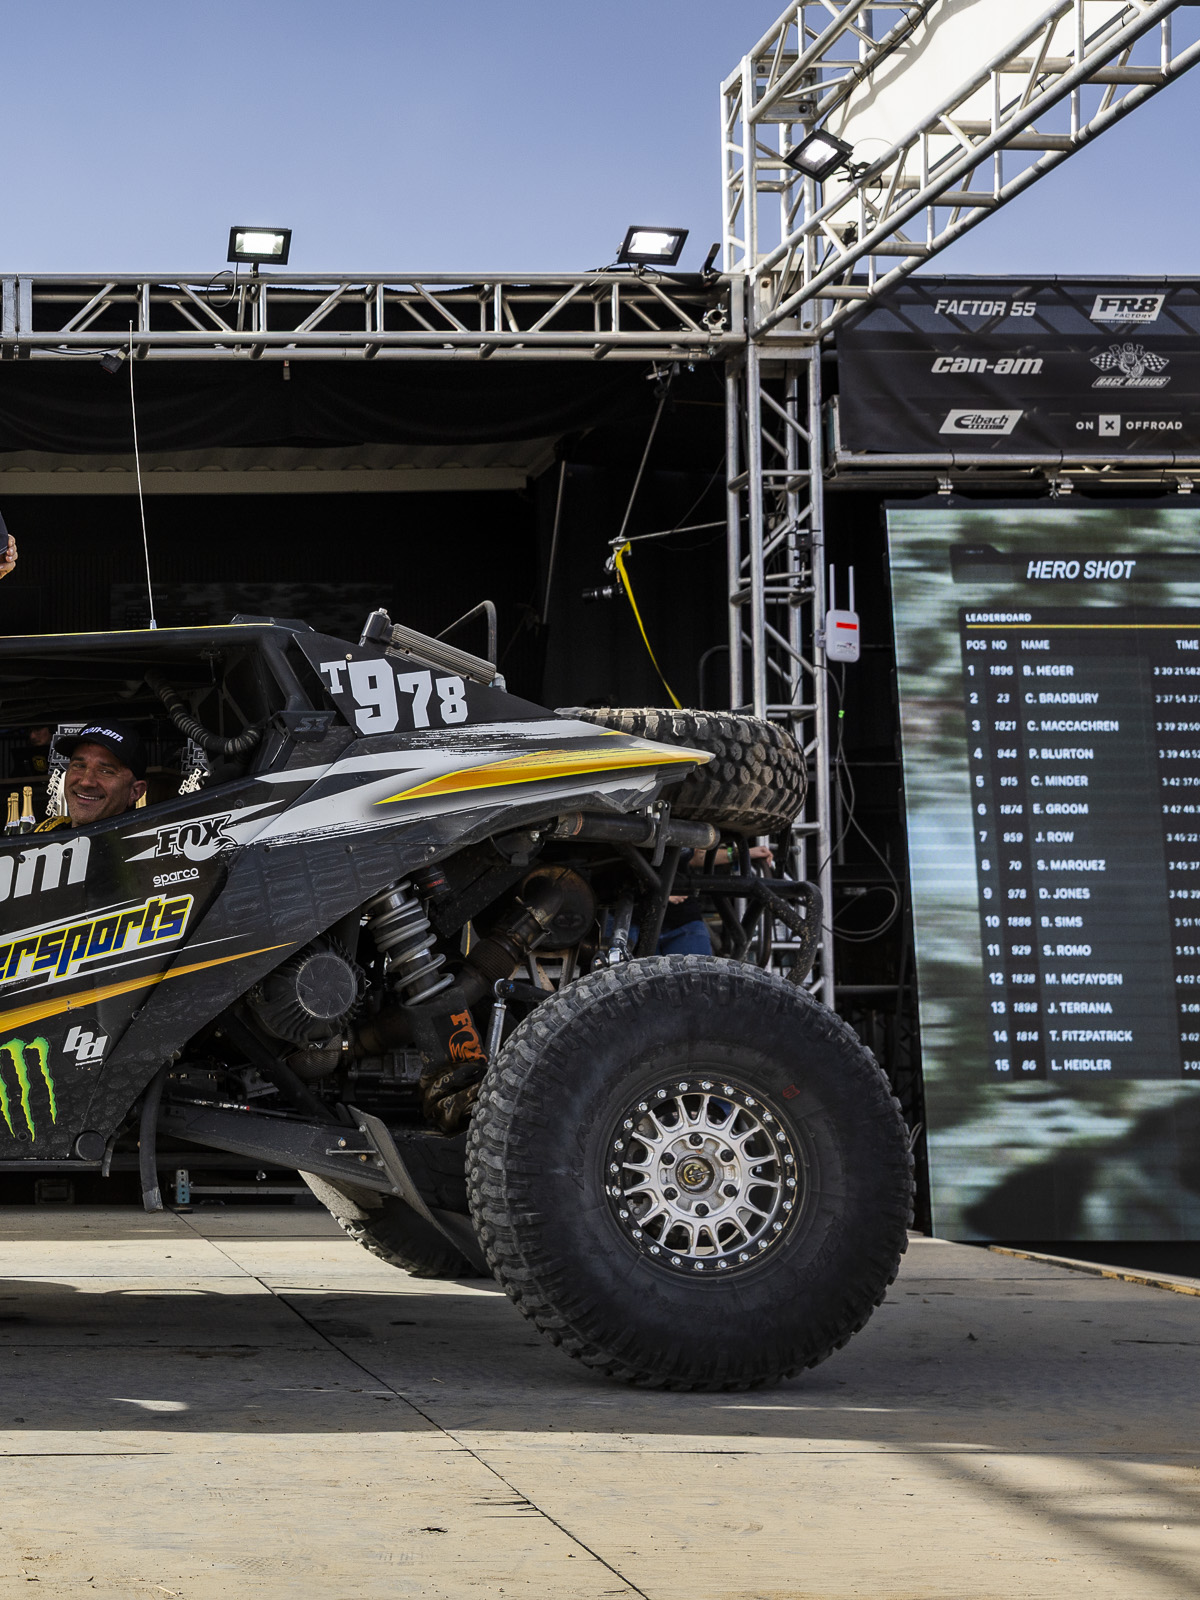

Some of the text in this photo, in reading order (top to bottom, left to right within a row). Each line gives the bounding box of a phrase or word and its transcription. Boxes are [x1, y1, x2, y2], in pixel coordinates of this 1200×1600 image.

[934, 299, 1037, 317] FACTOR 55
[1099, 297, 1159, 312] FR8
[931, 357, 1043, 375] can-am
[1095, 377, 1123, 387] RACE
[953, 413, 1009, 430] Eibach
[1076, 421, 1094, 430] ON
[1125, 420, 1183, 431] OFFROAD
[1026, 560, 1136, 579] HERO SHOT
[965, 613, 1032, 623] LEADERBOARD
[966, 639, 1199, 651] POS NO NAME TIME
[967, 664, 975, 676] 1
[1022, 665, 1035, 676] B.
[1035, 664, 1074, 676] HEGER
[969, 692, 979, 704] 2
[1024, 692, 1037, 704] C.
[1038, 692, 1099, 704] BRADBURY
[971, 719, 981, 732] 3
[1026, 720, 1039, 732] C.
[1040, 720, 1119, 732] MACCACHREN
[81, 726, 124, 743] can-am
[973, 747, 983, 760] 4
[1028, 748, 1040, 759] P.
[1040, 748, 1094, 760] BLURTON
[975, 775, 985, 788] 5
[1030, 775, 1043, 787] C.
[1044, 775, 1089, 787] MINDER
[977, 803, 987, 816] 6
[1032, 803, 1044, 815] E.
[1045, 803, 1089, 815] GROOM
[155, 814, 237, 861] FOX
[979, 830, 988, 843] 7
[1034, 831, 1046, 843] J.
[1046, 831, 1074, 843] ROW
[981, 859, 991, 871] 8
[1036, 859, 1049, 871] S.
[1049, 859, 1106, 872] MARQUEZ
[153, 867, 200, 887] sparco
[983, 887, 993, 900] 9
[1038, 887, 1052, 900] D.
[1052, 887, 1091, 900] JONES
[985, 915, 1000, 928] 10
[1040, 915, 1053, 928] B.
[1054, 915, 1083, 928] SIMS
[986, 943, 1000, 957] 11
[1042, 944, 1056, 957] S.
[1056, 944, 1092, 957] ROMO
[988, 972, 1004, 985] 12
[1044, 973, 1060, 985] M.
[1060, 972, 1123, 986] MCFAYDEN
[990, 1001, 1006, 1014] 13
[1047, 1002, 1058, 1014] J.
[1059, 1001, 1113, 1014] TERRANA
[993, 1030, 1008, 1043] 14
[1048, 1029, 1060, 1042] T.
[1061, 1029, 1133, 1042] FITZPATRICK
[994, 1058, 1010, 1071] 15
[1051, 1059, 1063, 1071] L.
[1063, 1058, 1112, 1071] HEIDLER
